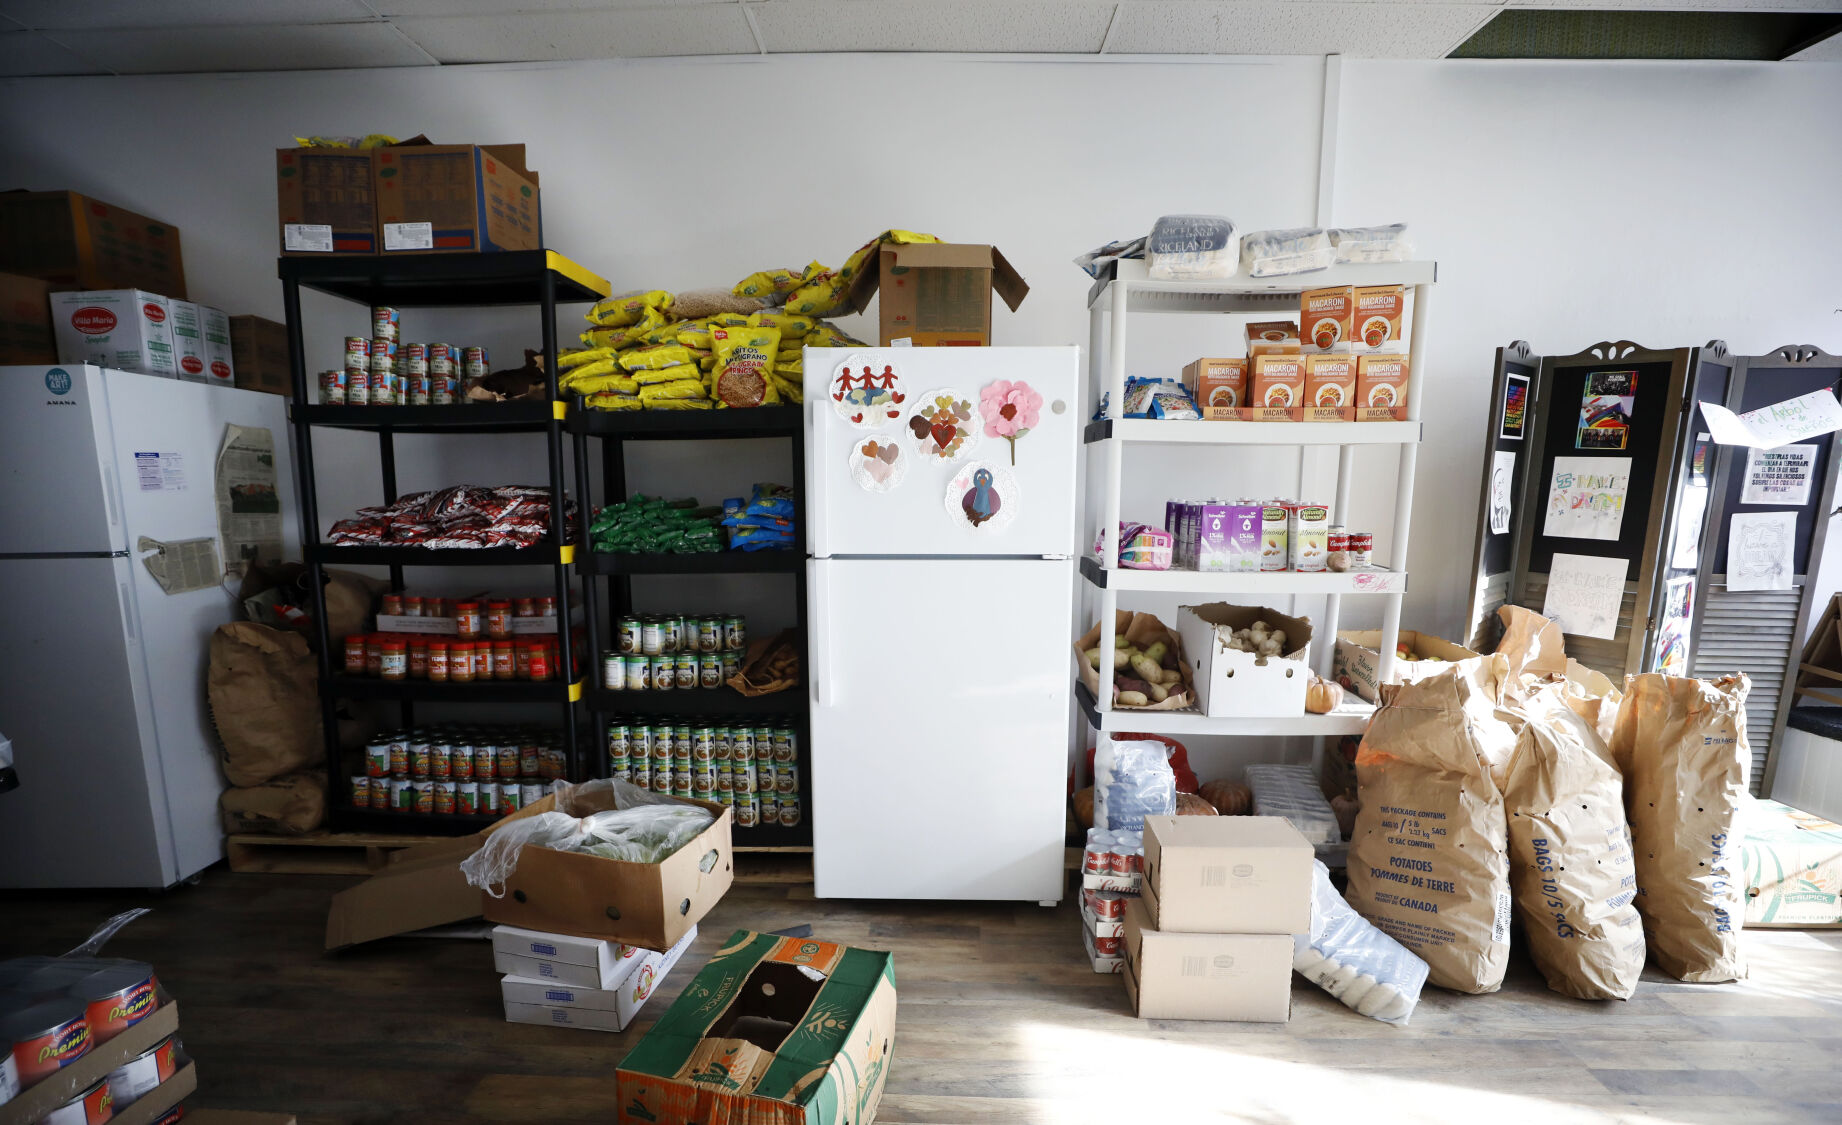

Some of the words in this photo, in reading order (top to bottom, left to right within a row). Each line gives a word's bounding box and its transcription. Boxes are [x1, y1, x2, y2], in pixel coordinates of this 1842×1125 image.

[1158, 239, 1213, 252] RICELAND
[1309, 297, 1344, 308] MACARONI
[1360, 296, 1396, 305] MACARONI
[1208, 367, 1240, 375] MACARONI
[1264, 364, 1297, 373] MACARONI
[1314, 364, 1349, 372] MACARONI
[1367, 364, 1401, 372] MACARONI
[50, 381, 68, 389] ART!
[1263, 409, 1294, 417] MACARONI
[1391, 808, 1417, 817] PACKAGE
[1418, 811, 1447, 820] CONTAINS
[1422, 830, 1430, 839] kg
[1431, 827, 1447, 836] SACS
[1395, 838, 1406, 846] SAC
[1407, 839, 1436, 849] CONTIENT
[1711, 833, 1728, 864] SACS
[1531, 838, 1553, 873] BAGS
[1390, 856, 1433, 873] POTATOES
[1370, 868, 1409, 884] POMMES
[1411, 876, 1424, 888] DE
[1427, 879, 1455, 894] TERRE
[1541, 878, 1563, 909] 10/5
[1605, 889, 1637, 910] POMME
[1399, 897, 1438, 914] CANADA
[1407, 921, 1423, 930] NAME
[1407, 928, 1430, 939] PLAINLY
[123, 990, 139, 1003] PORT
[700, 977, 734, 1012] FRUPICK
[109, 988, 157, 1023] Premiu
[55, 1028, 71, 1042] PORT
[38, 1025, 91, 1064] Premiu
